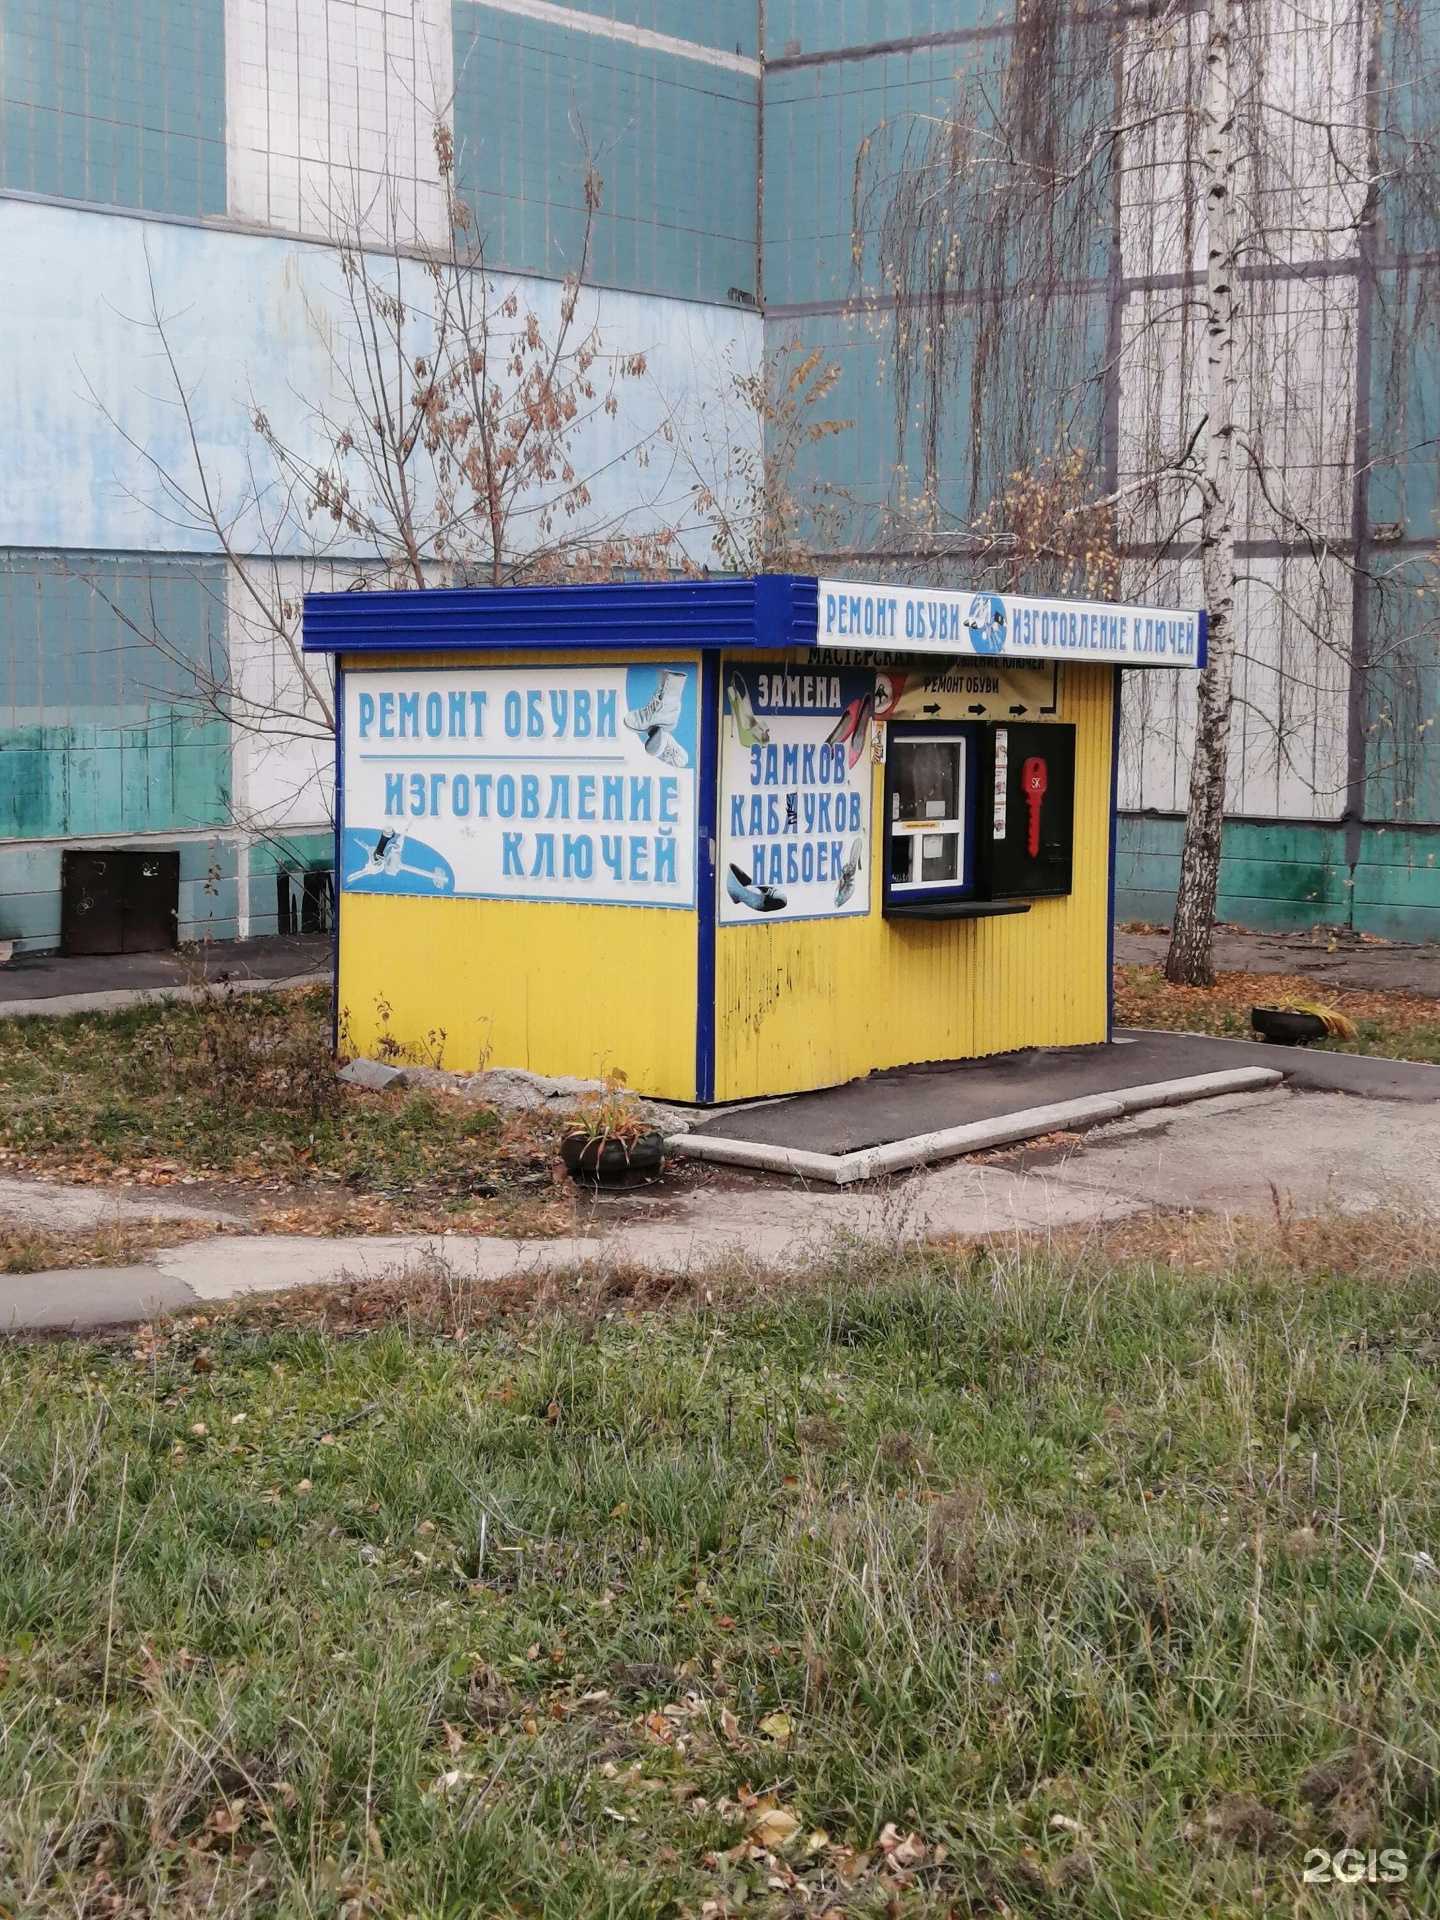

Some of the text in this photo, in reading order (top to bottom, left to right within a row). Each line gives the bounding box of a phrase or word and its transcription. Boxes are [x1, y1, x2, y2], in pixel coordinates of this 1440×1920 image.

[826, 595, 960, 641] РЕМОНТ ОБУВИ
[1012, 608, 1194, 655] ИЗГОТОВЛЕНИЕ КЛЮЧЕЙ
[758, 674, 841, 708] ЗАМЕНА
[923, 676, 999, 693] РЕМОНТ ОБУВИ
[358, 689, 617, 738] РЕМОНТ ОБУВИ
[384, 773, 679, 823] ИЗГОТОВЛЕНИЕ
[501, 827, 677, 883] КЛЮЧЕЙ
[752, 841, 843, 885] НАБОЕК
